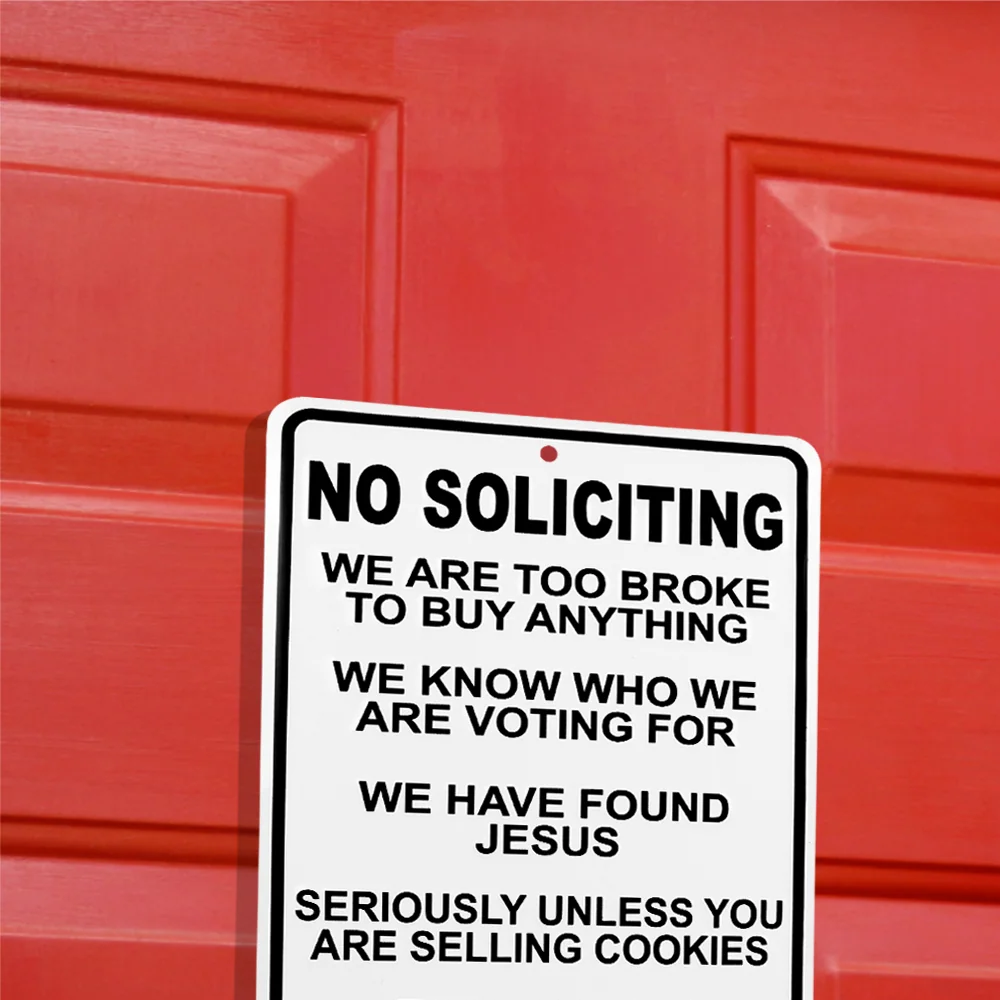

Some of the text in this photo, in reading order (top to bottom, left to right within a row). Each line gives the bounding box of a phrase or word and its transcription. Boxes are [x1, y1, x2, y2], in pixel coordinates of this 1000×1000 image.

[307, 460, 783, 552] NO SOLICITING
[320, 551, 770, 610] WE ARE TOO BROKE
[345, 591, 748, 645] TO BUY ANYTHING
[332, 660, 757, 712] WE KNOW WHO WE
[355, 700, 736, 748] ARE VOTING FOR
[358, 780, 730, 823] WE HAVE FOUND
[475, 823, 619, 858] JESUS
[294, 888, 783, 930] SERIOUSLY UNLESS YOU
[309, 928, 768, 967] ARE SELLING COOKIES
